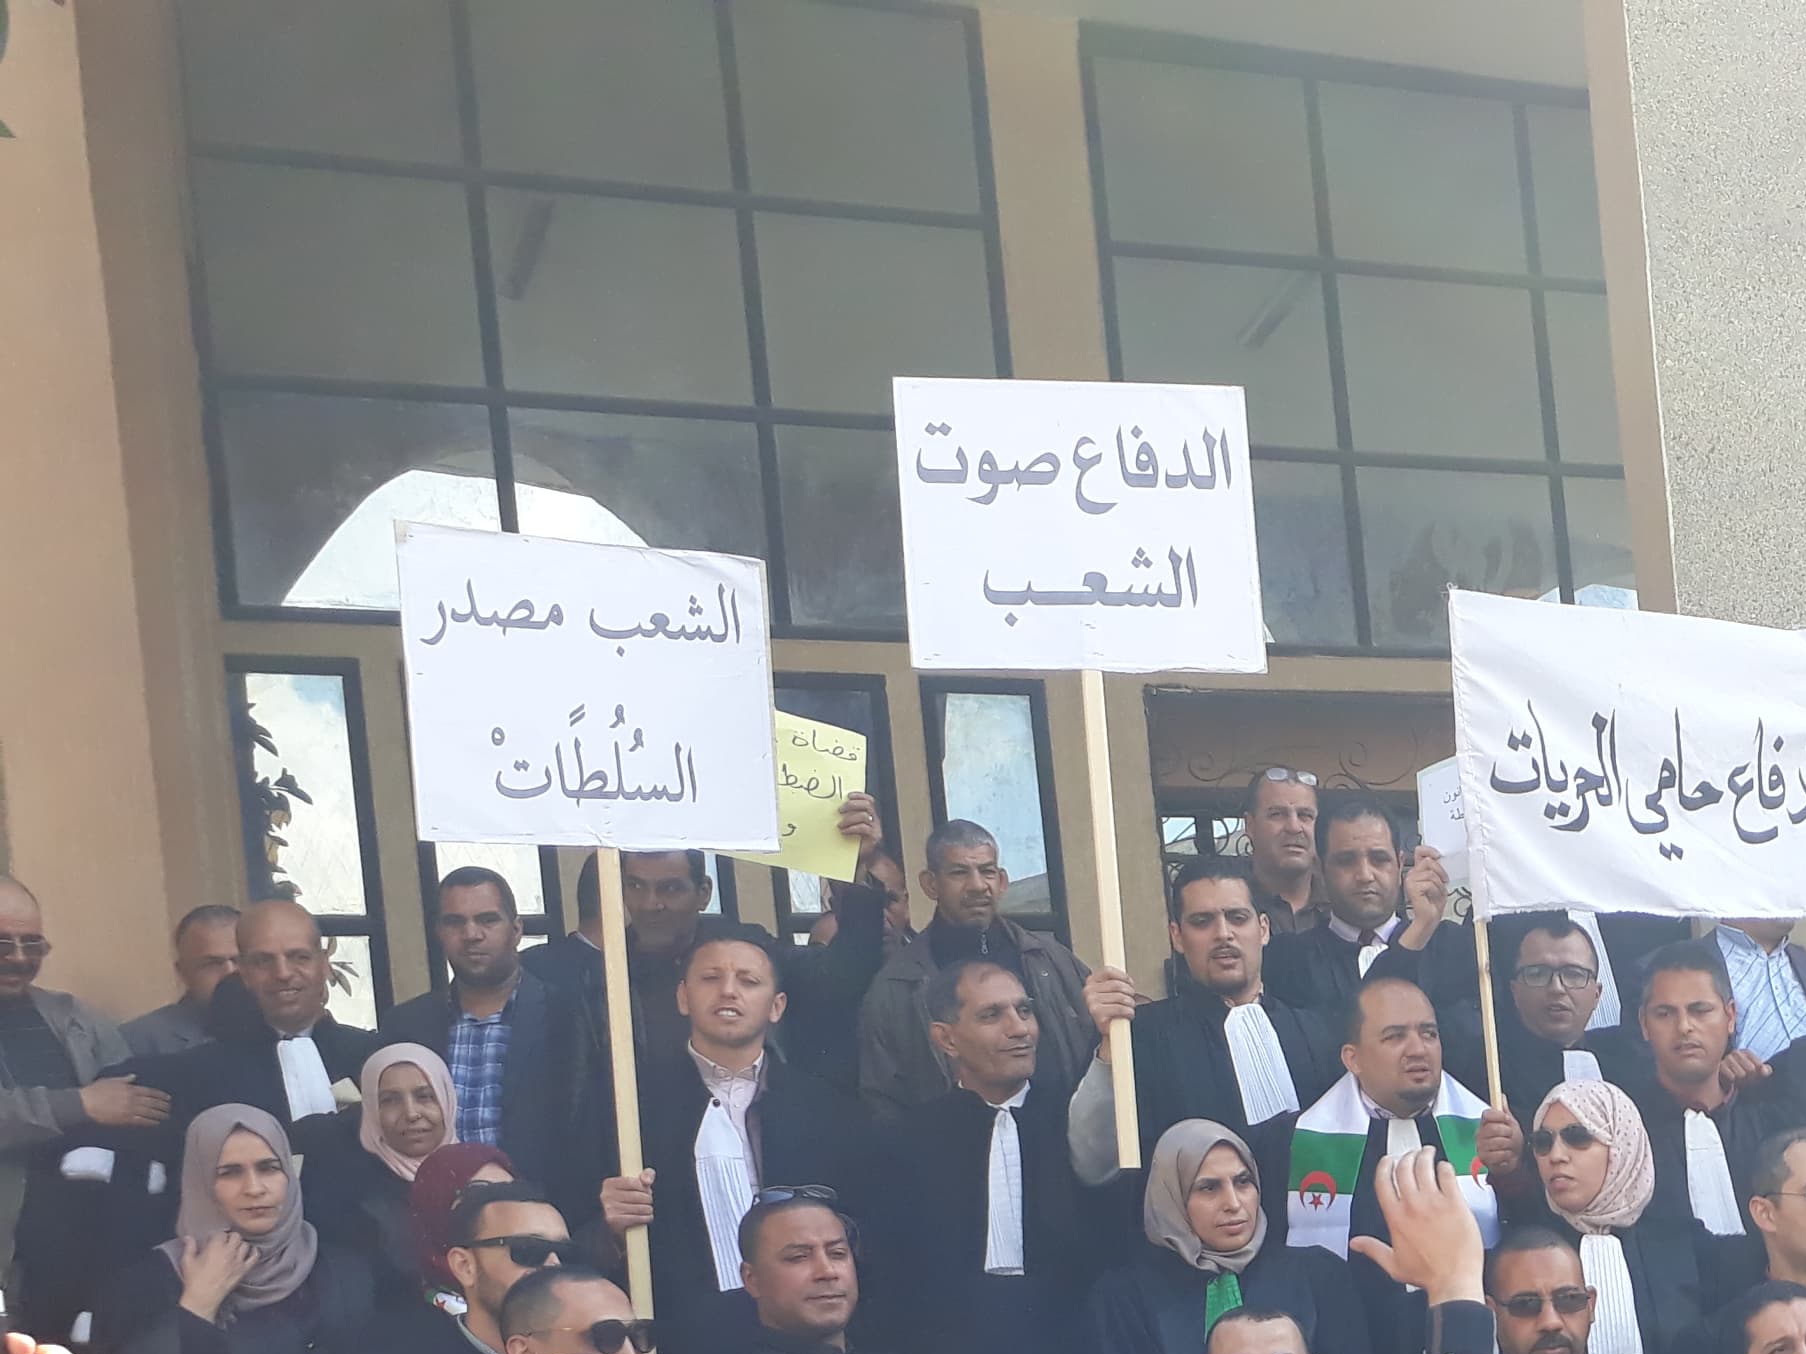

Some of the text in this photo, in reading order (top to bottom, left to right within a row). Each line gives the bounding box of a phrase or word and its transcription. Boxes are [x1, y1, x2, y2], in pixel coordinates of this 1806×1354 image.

[915, 421, 1233, 515] الدفاع صوت
[419, 578, 743, 657] الشعب مصدر
[982, 545, 1200, 625] الشعب
[791, 728, 861, 762] قضاة
[1489, 698, 1623, 832] الحريات
[1625, 706, 1725, 861] حامي
